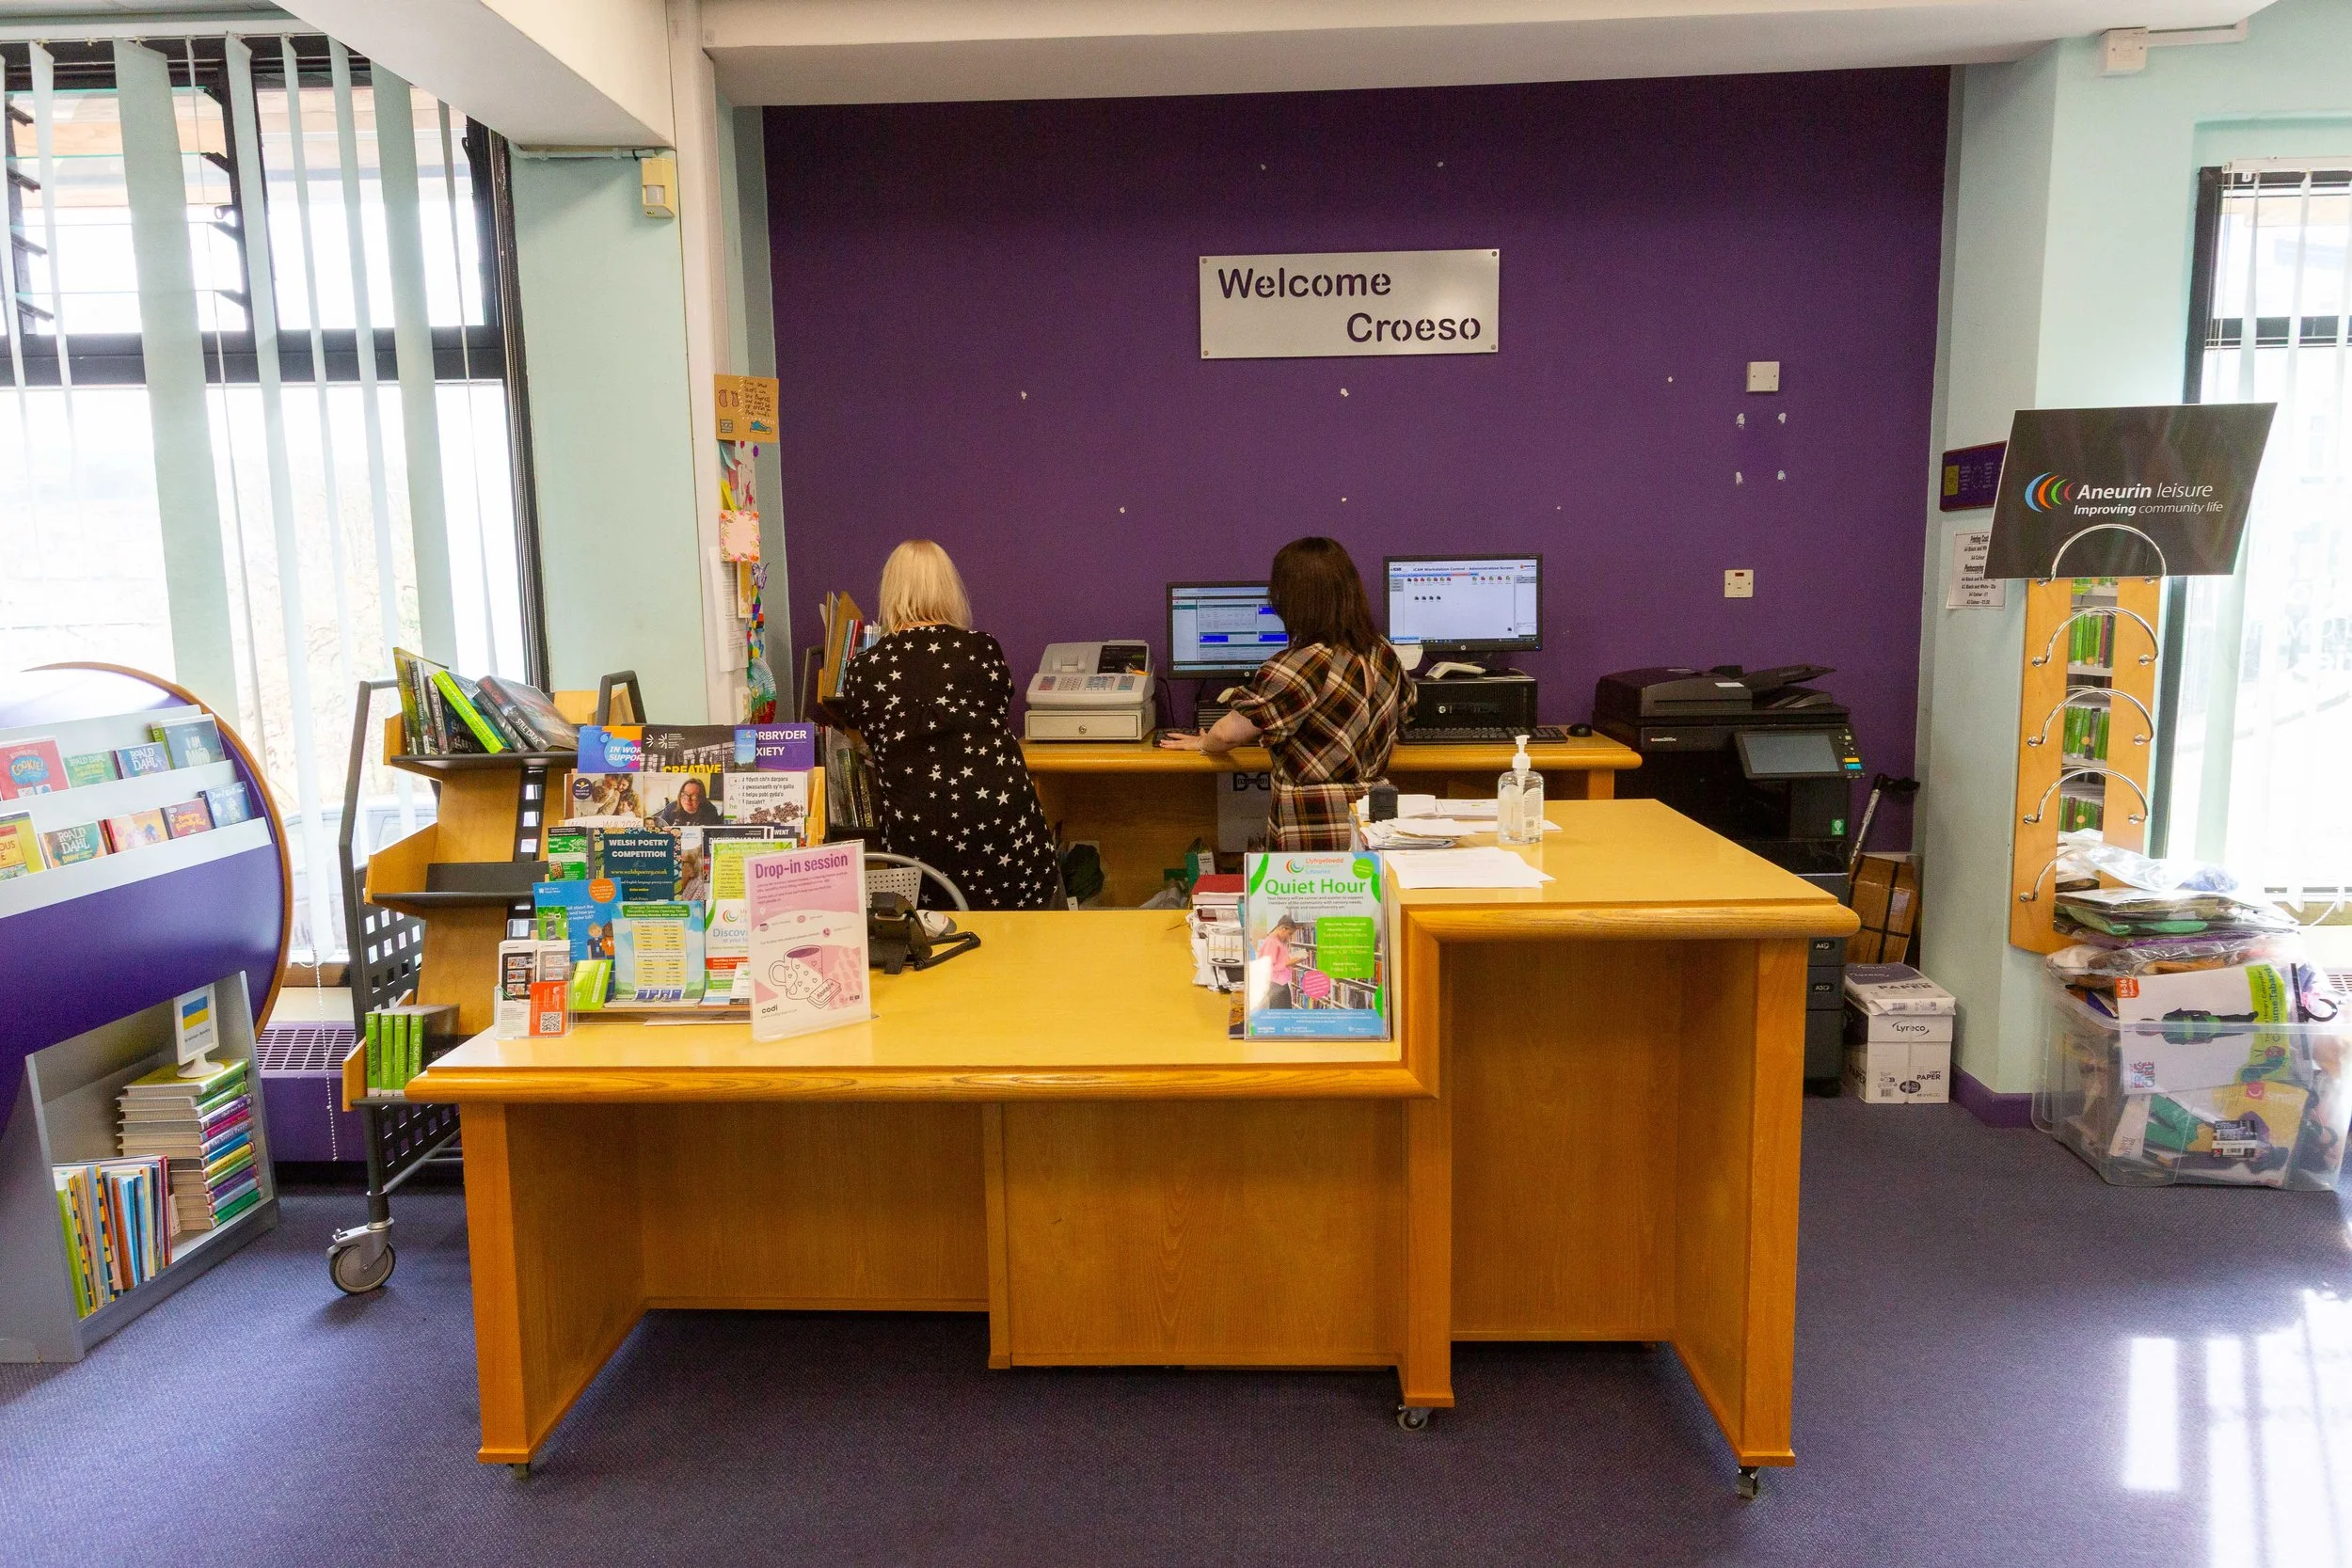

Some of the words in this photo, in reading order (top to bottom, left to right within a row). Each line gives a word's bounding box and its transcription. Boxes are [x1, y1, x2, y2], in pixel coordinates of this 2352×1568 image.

[1218, 267, 1391, 299] Welcome
[1346, 312, 1481, 342] Croeso
[2076, 483, 2152, 500] Aneurin
[2156, 483, 2214, 499] leisure
[2074, 504, 2137, 517] Improving
[2138, 502, 2204, 515] community
[2206, 501, 2224, 513] life
[130, 747, 155, 760] ROALD
[12, 760, 44, 776] COOKIE!
[132, 756, 159, 769] DAHL
[56, 828, 87, 843] ROALD
[60, 839, 90, 855] DAHL
[755, 860, 802, 879] Drop-in
[804, 854, 849, 872] session
[1264, 879, 1315, 895] Quiet
[1320, 879, 1367, 894] Hour
[2119, 979, 2127, 998] 18-36
[2269, 967, 2280, 1000] Tabard
[761, 1005, 778, 1014] codi
[1896, 1024, 1926, 1033] Lyreco
[2133, 1061, 2143, 1089] ERIC
[2143, 1061, 2154, 1088] CARLE
